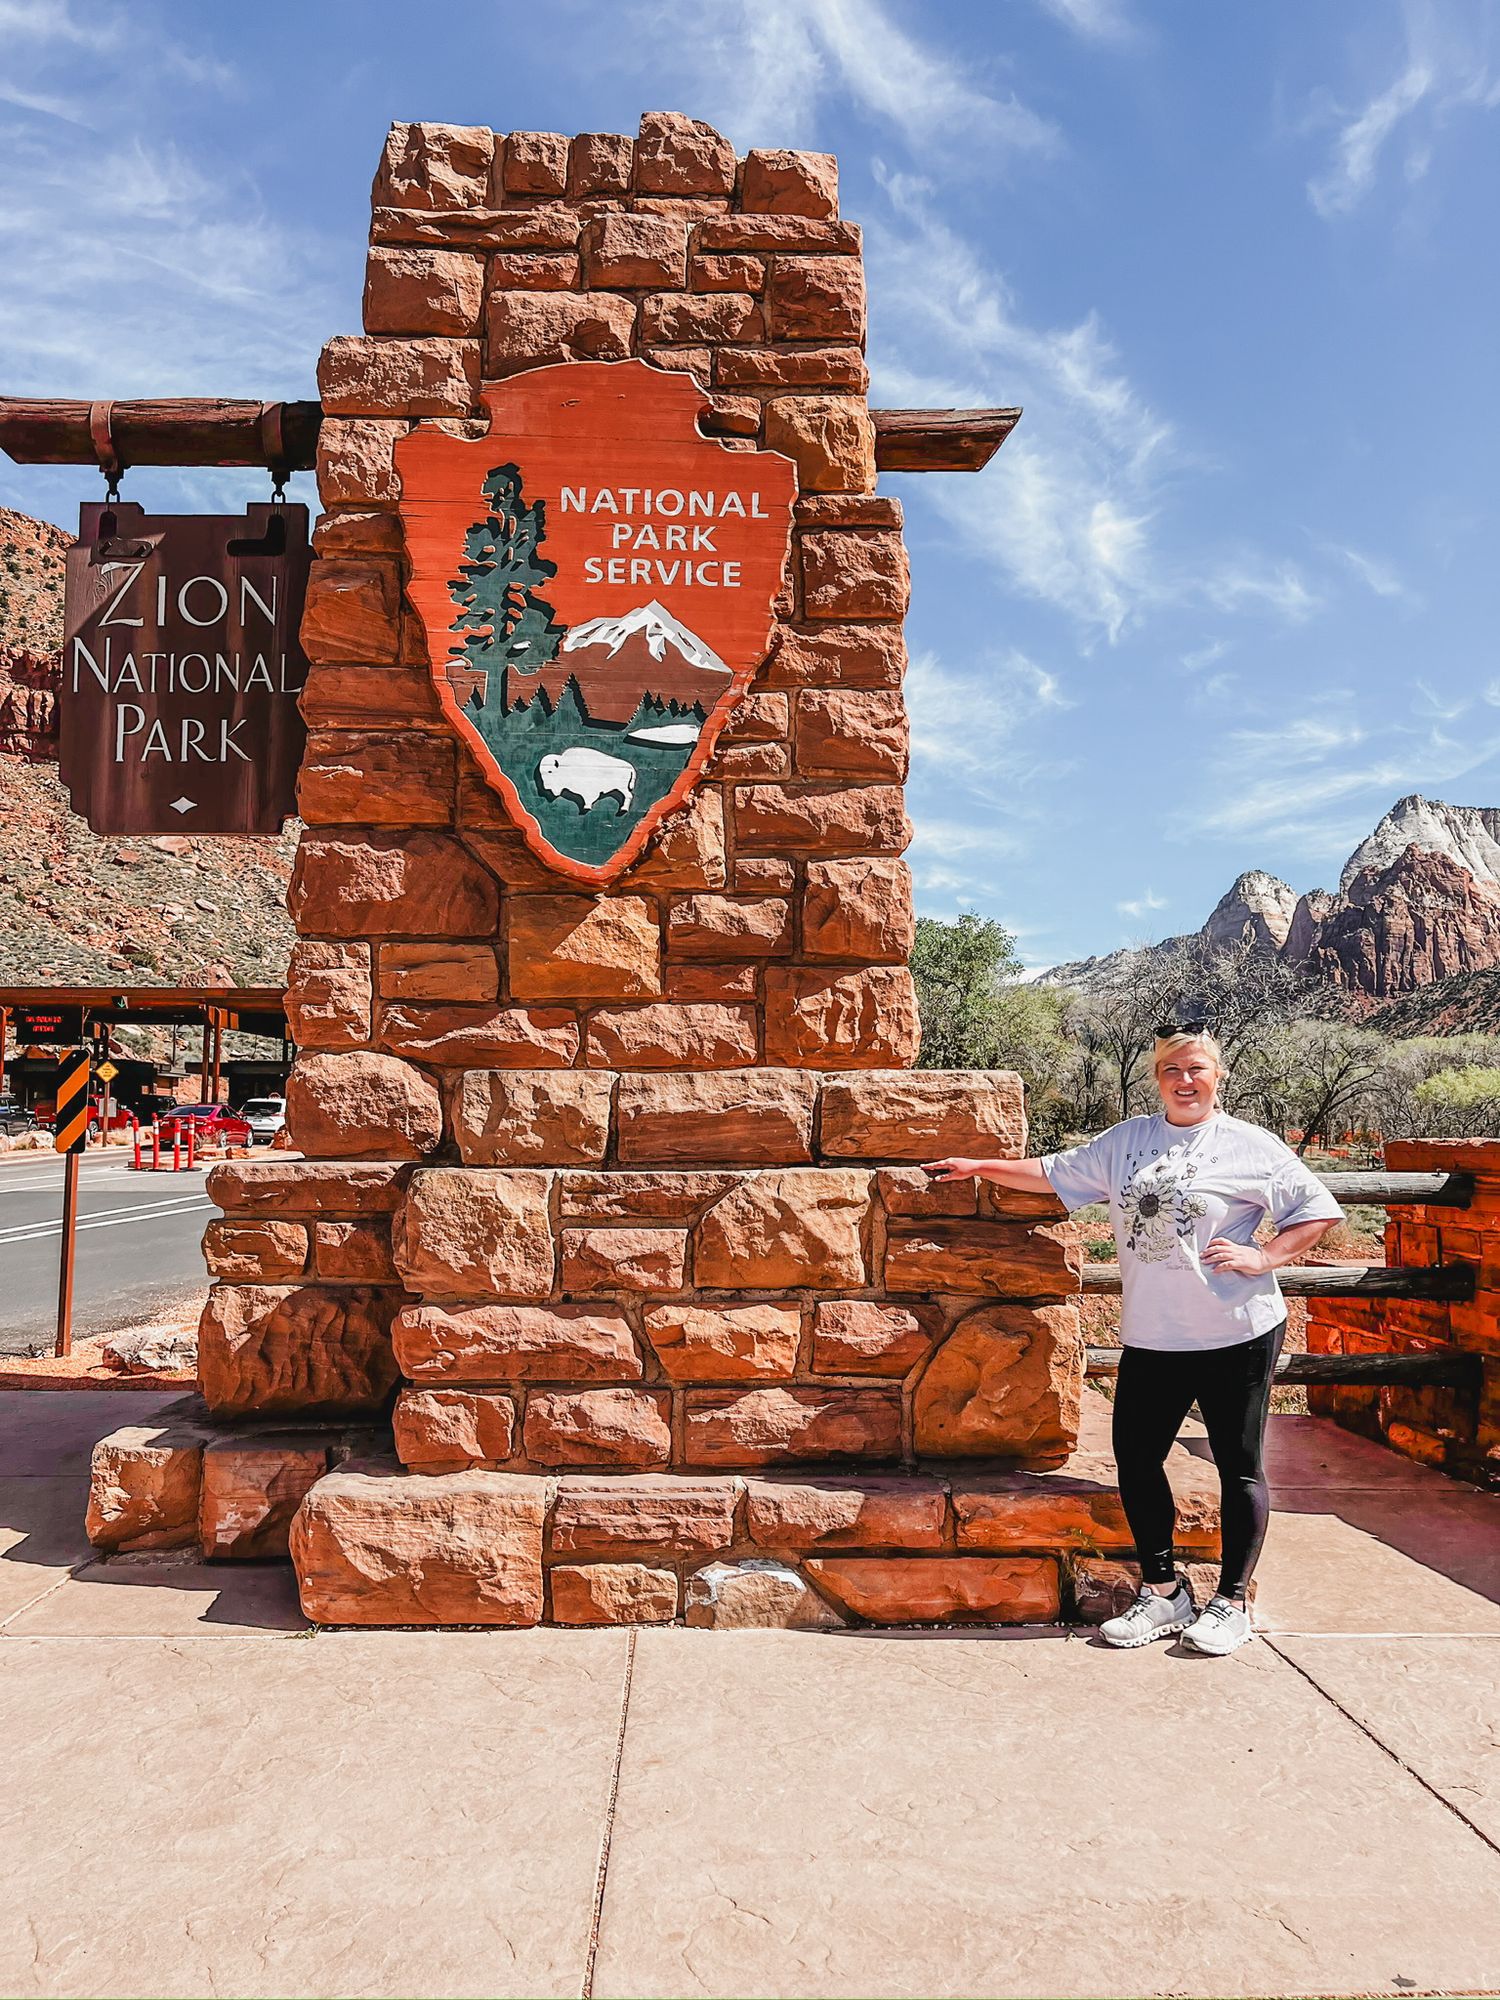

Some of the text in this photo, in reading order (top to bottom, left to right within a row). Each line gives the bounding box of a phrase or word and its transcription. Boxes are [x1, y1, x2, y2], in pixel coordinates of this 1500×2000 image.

[560, 486, 770, 519] NATIONAL
[612, 523, 718, 552] PARK
[583, 556, 742, 588] SERVICE
[97, 561, 278, 628] ZION
[71, 636, 303, 694] NATIONAL
[114, 703, 253, 763] PARK
[1126, 1148, 1219, 1164] FLOWERS
